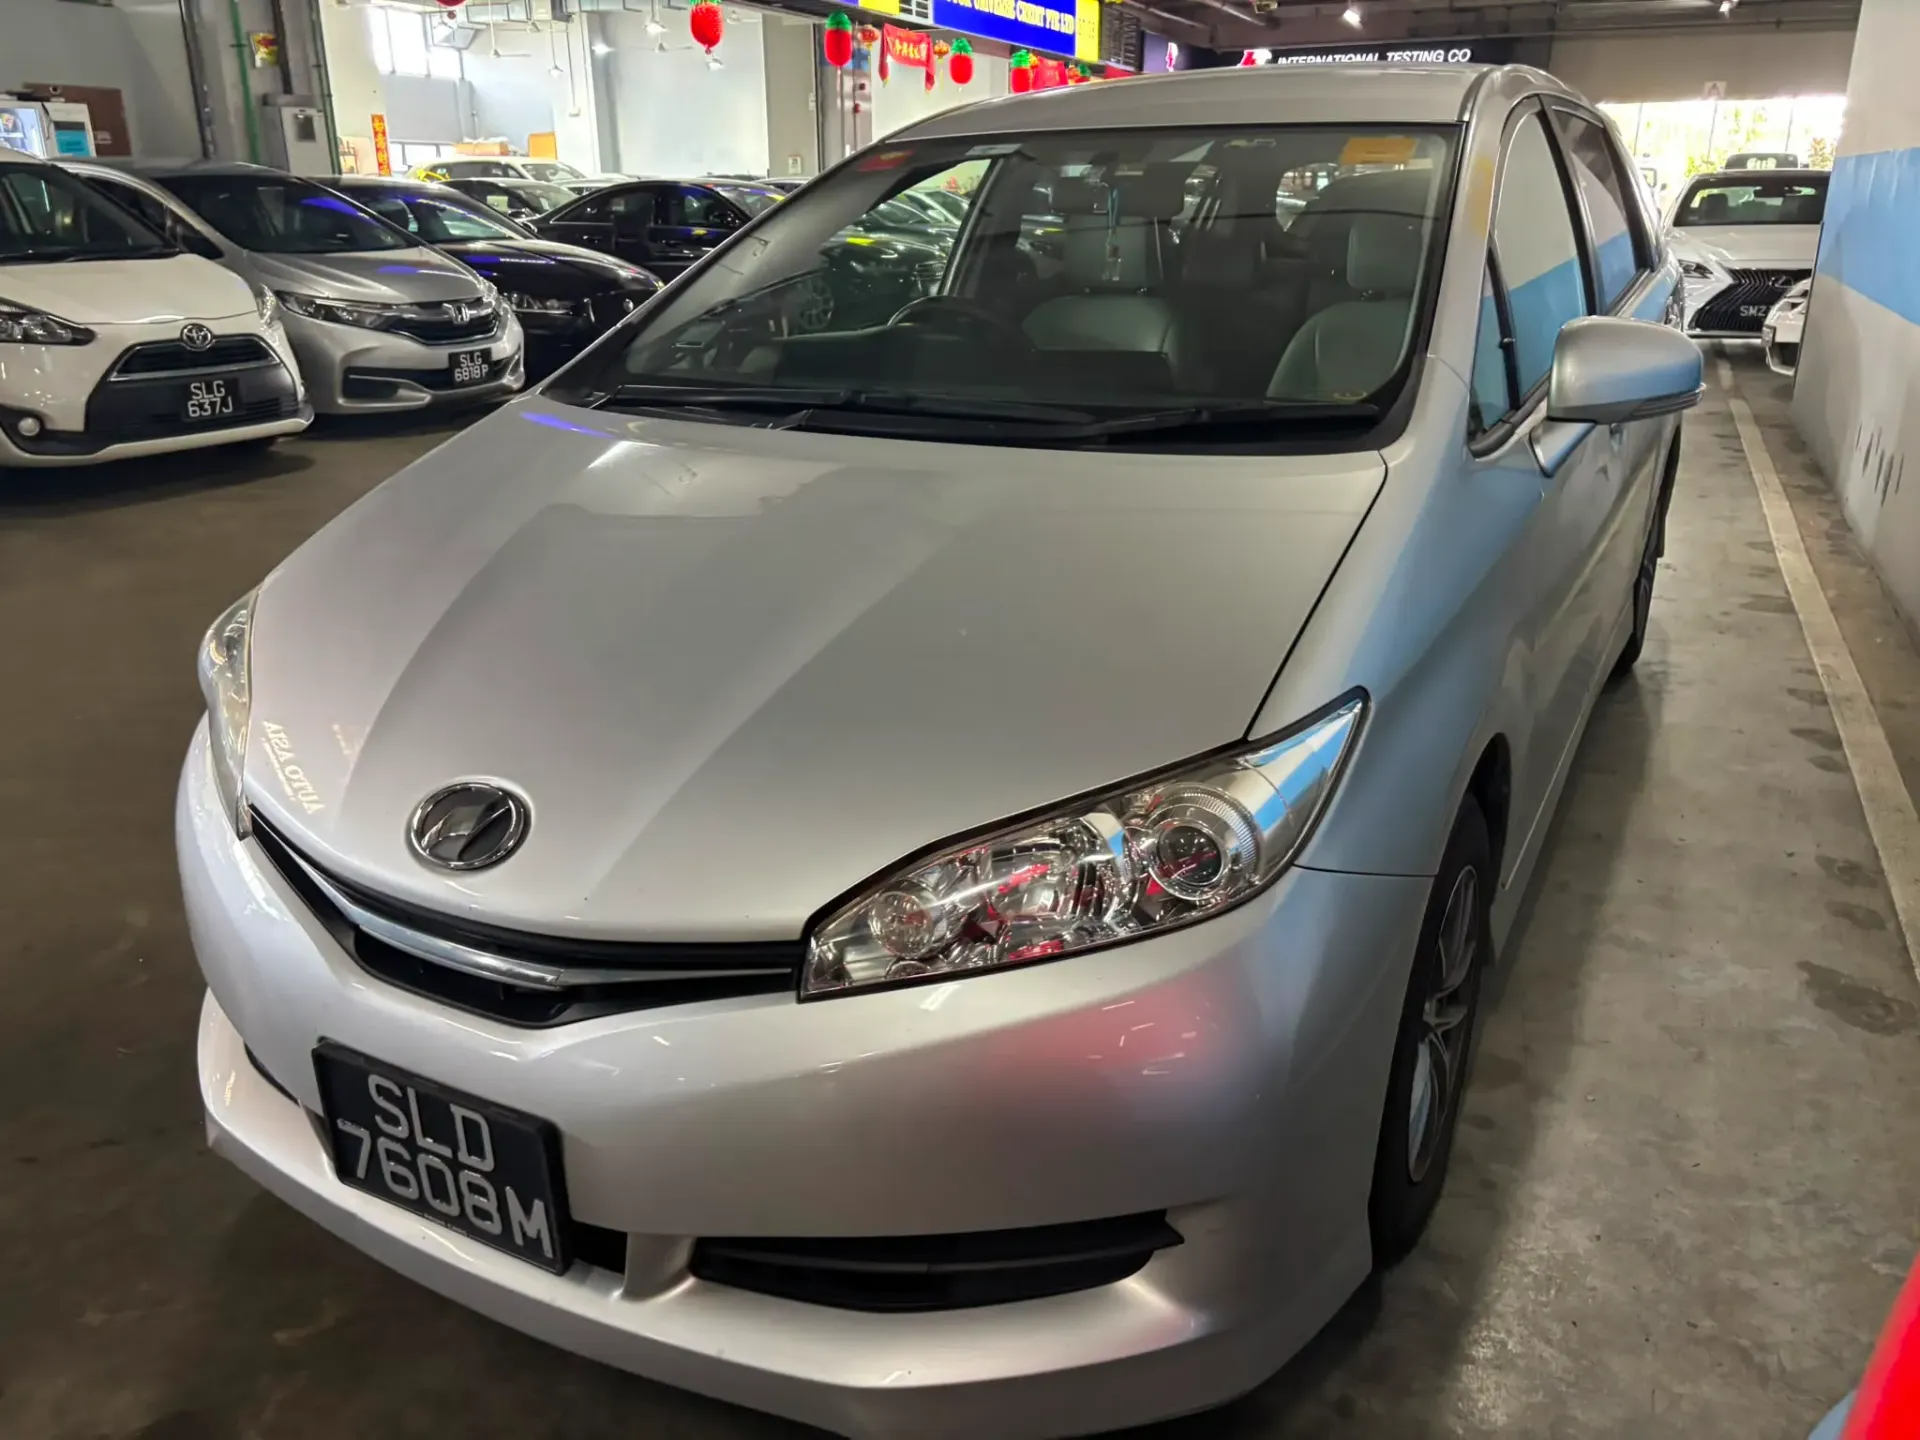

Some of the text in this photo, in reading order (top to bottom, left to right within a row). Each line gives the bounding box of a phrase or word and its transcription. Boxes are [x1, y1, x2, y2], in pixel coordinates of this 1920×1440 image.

[1386, 50, 1443, 62] TESTING
[1447, 48, 1471, 63] CO
[460, 352, 482, 367] SLG
[454, 364, 489, 382] 6818P
[190, 380, 226, 400] SLG
[187, 396, 233, 417] 637J
[367, 1074, 495, 1172] SLD
[336, 1118, 554, 1259] 7608M
